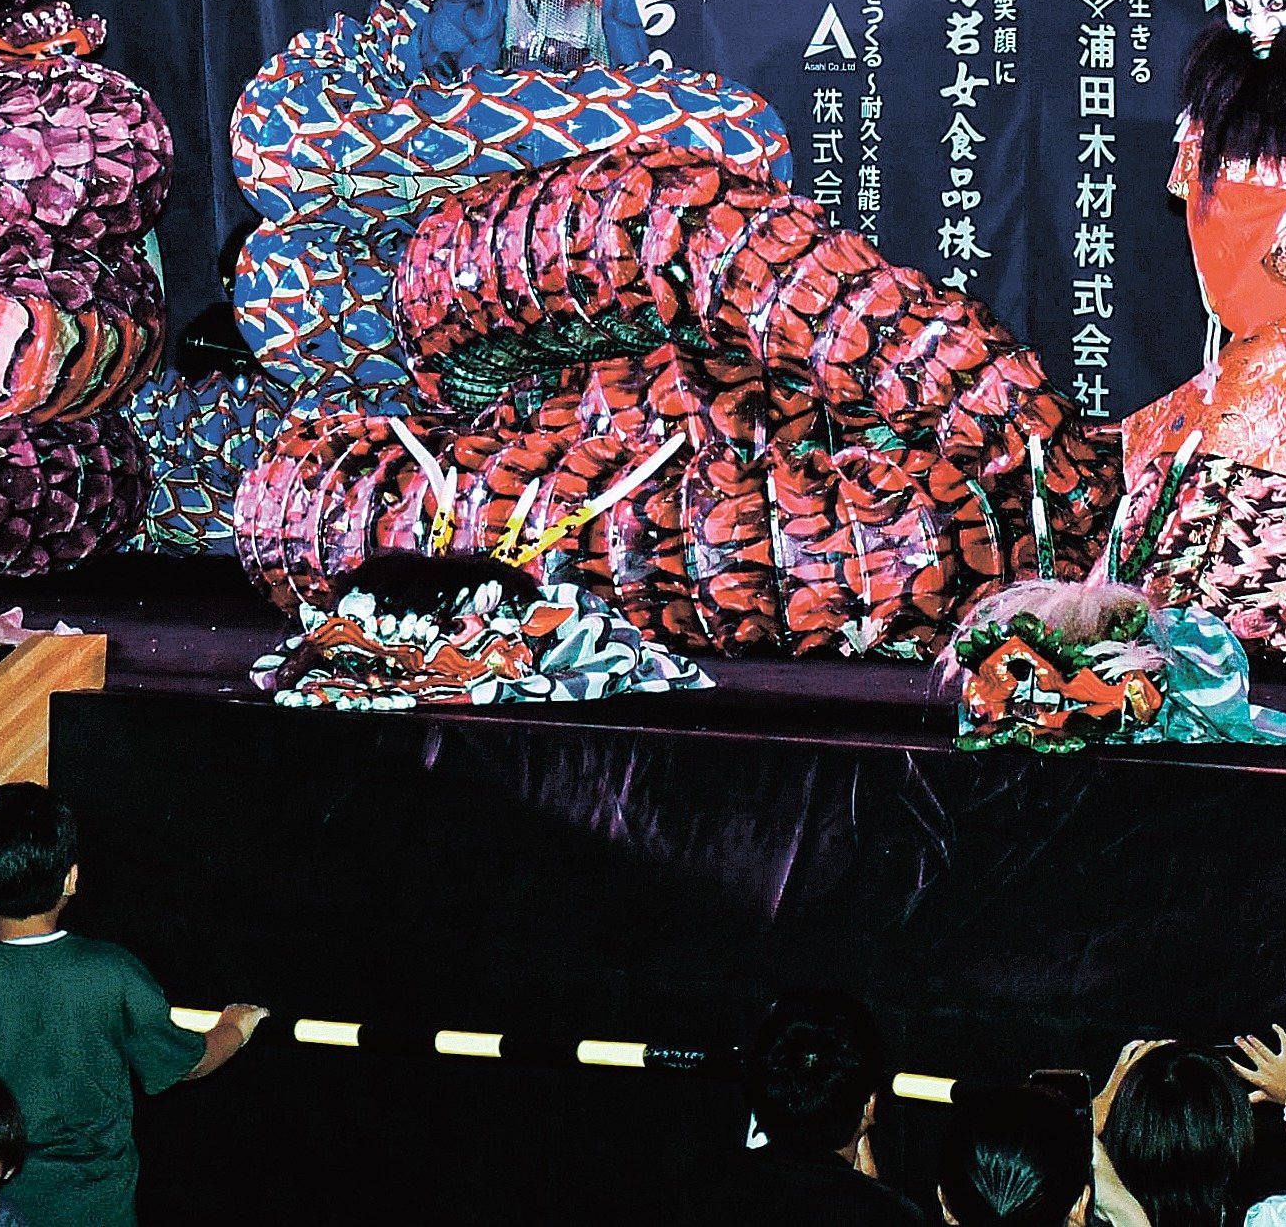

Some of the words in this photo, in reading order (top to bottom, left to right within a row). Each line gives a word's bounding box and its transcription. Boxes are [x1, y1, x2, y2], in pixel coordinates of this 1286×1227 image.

[804, 62, 827, 72] Asahi
[1071, 23, 1117, 418] 浦田木材株式会社
